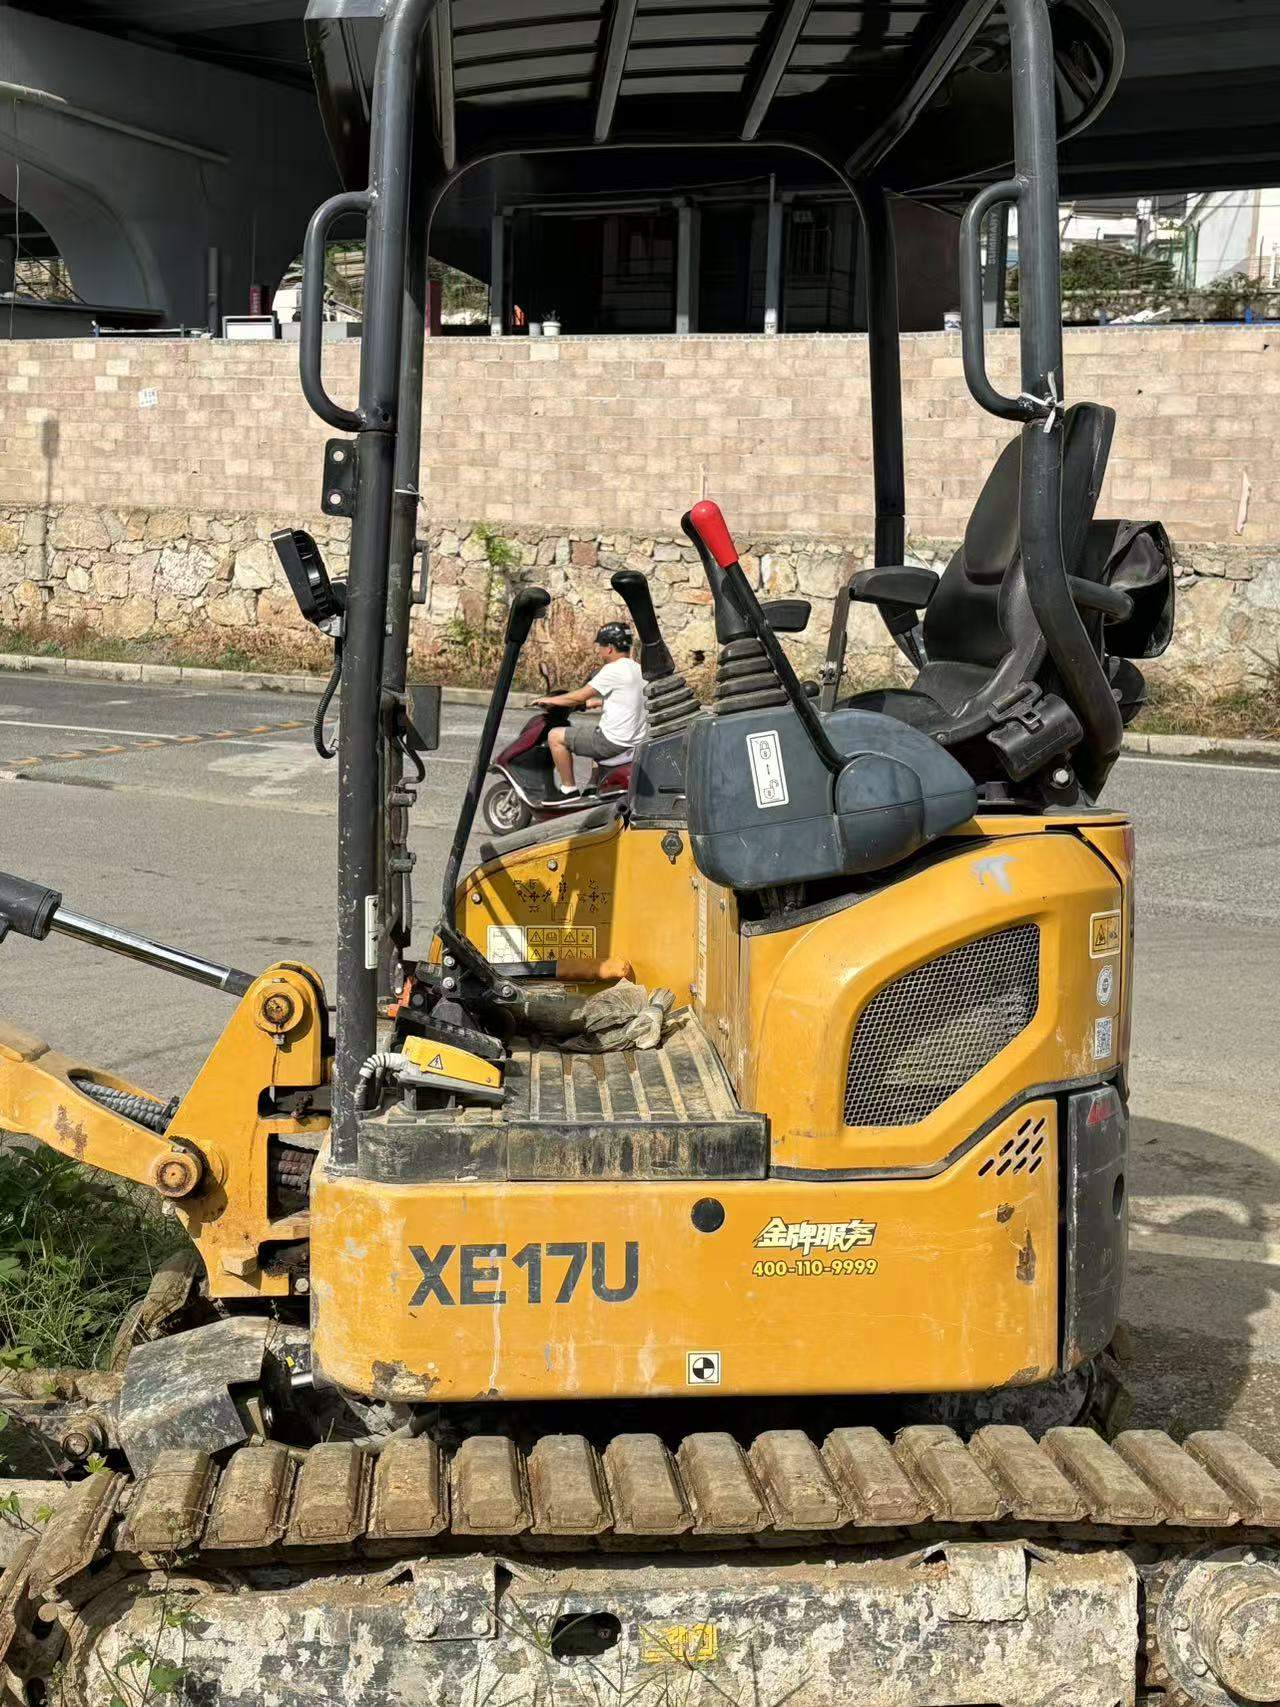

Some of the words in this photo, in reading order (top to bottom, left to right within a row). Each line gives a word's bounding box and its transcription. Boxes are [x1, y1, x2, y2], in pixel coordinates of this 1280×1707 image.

[752, 1217, 878, 1257] 金牌服务
[408, 1242, 639, 1306] XE17U
[752, 1259, 878, 1277] 400-110-9999
